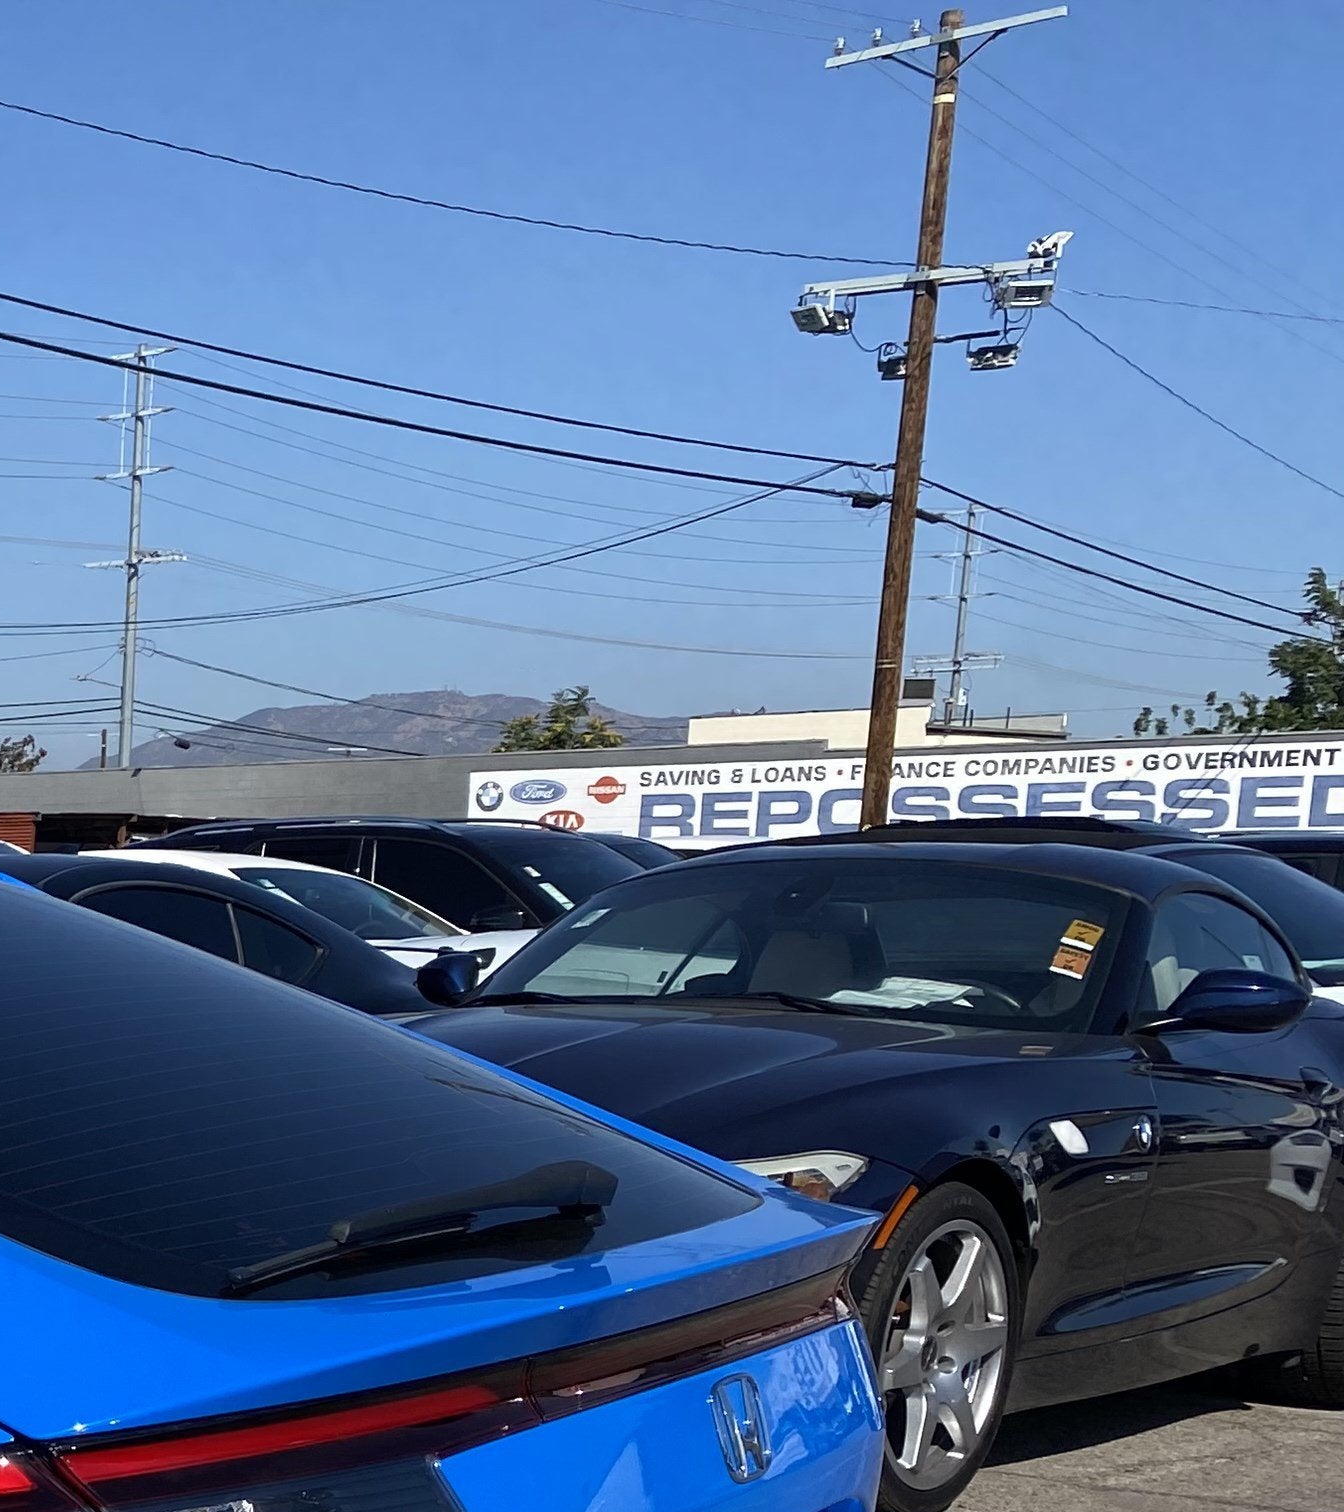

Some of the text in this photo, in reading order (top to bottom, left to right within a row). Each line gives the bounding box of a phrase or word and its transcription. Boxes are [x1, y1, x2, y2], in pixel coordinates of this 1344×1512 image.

[639, 748, 1342, 787] SAVING & LOANS FANCE COMPANIES GOVERNMENT
[521, 783, 555, 799] Ford
[588, 785, 625, 795] NISSAN
[545, 813, 579, 828] KIA
